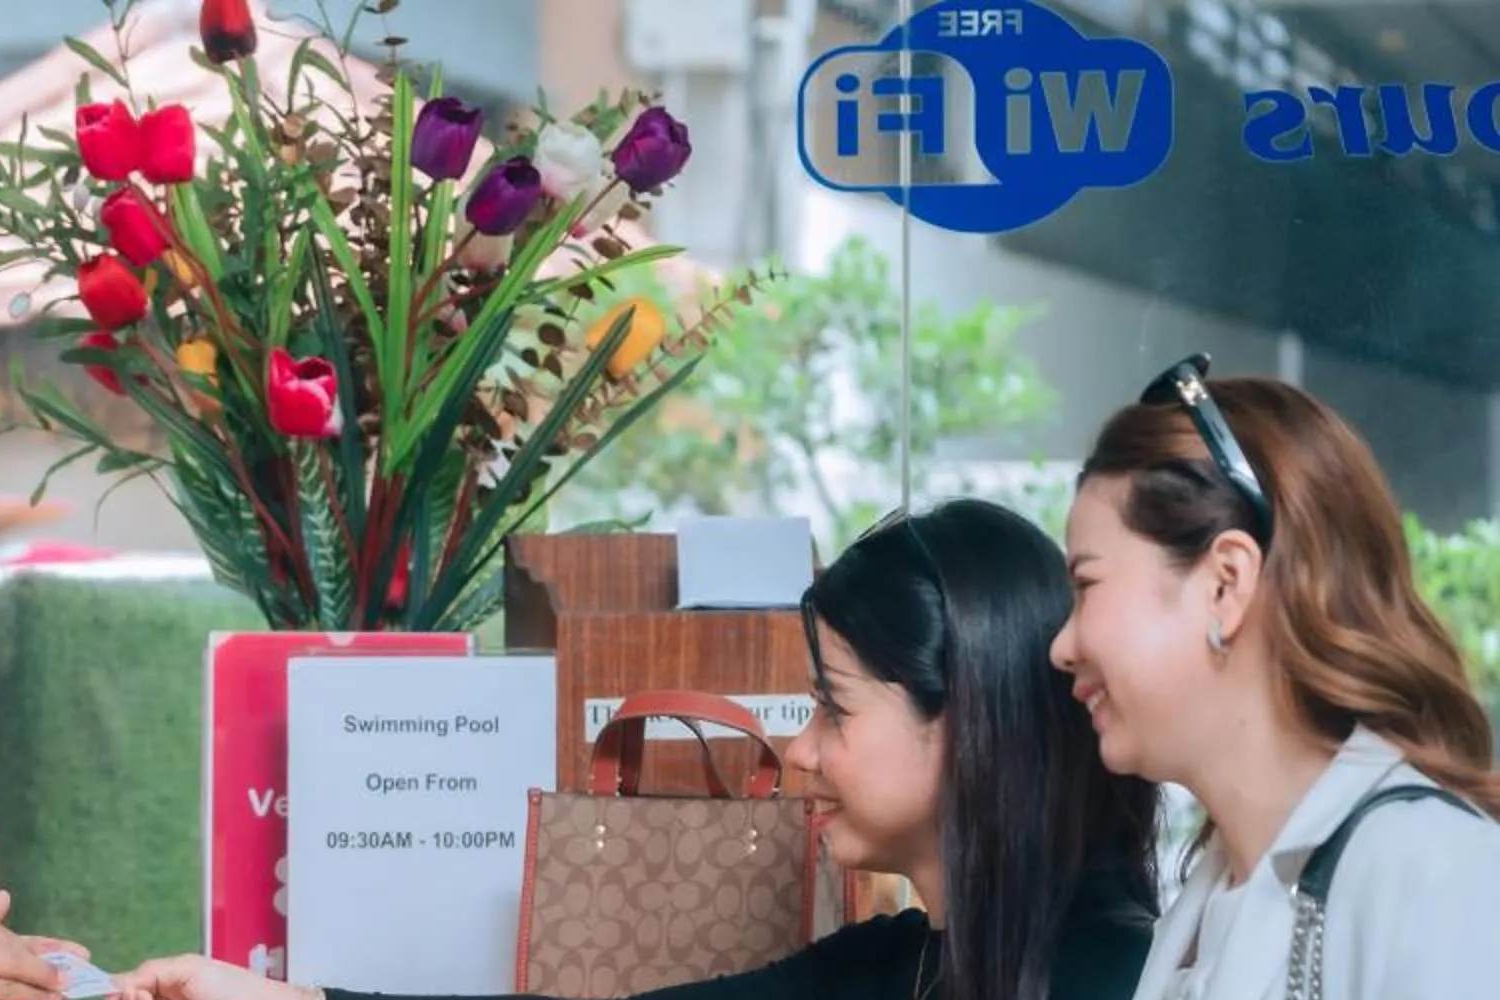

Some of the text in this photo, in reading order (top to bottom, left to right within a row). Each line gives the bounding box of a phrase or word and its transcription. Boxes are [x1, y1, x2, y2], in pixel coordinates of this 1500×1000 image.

[781, 700, 817, 726] tip
[344, 714, 500, 737] Swimming Pool
[366, 773, 478, 794] Open From
[326, 831, 413, 849] 09:30AM
[433, 831, 515, 849] 10:00PM
